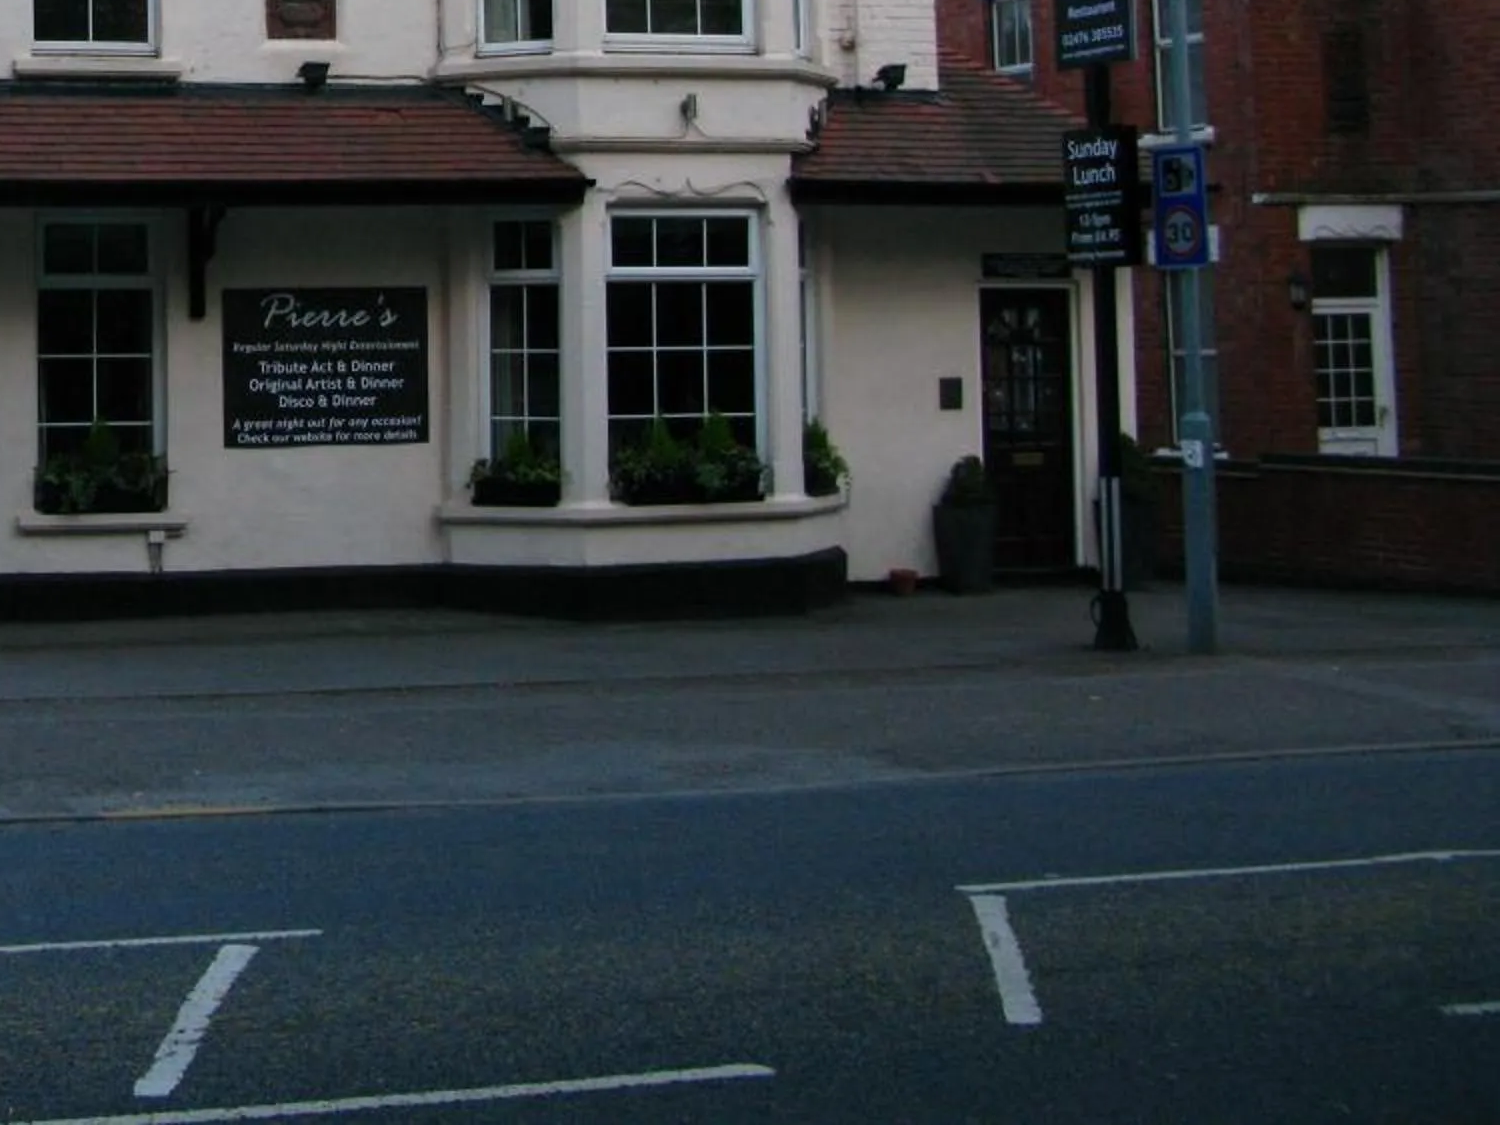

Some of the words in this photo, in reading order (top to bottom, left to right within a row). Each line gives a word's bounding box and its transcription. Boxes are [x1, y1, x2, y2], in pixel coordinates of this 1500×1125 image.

[1067, 0, 1116, 18] Restaurant
[1067, 138, 1117, 160] Sunday
[1073, 163, 1116, 185] Lunch
[1168, 222, 1192, 243] 30
[260, 291, 399, 328] Pierre's
[274, 341, 319, 353] Saturday
[322, 340, 347, 353] Night
[259, 361, 308, 374] Tribute
[311, 360, 332, 373] Act
[337, 360, 345, 372] &
[351, 360, 395, 372] Dinner
[250, 378, 302, 393] Original
[305, 378, 343, 390] Artist
[347, 378, 356, 389] &
[361, 376, 404, 389] Dinner
[279, 395, 315, 408] Disco
[318, 395, 328, 407] &
[332, 394, 377, 407] Dinner
[232, 419, 242, 430] A
[244, 419, 274, 432] great
[277, 418, 304, 431] night
[307, 418, 326, 428] out
[329, 416, 343, 430] for
[347, 417, 368, 429] any
[237, 432, 269, 444] Check
[271, 434, 289, 442] our
[293, 431, 332, 443] website
[335, 430, 350, 441] for
[354, 432, 381, 441] more
